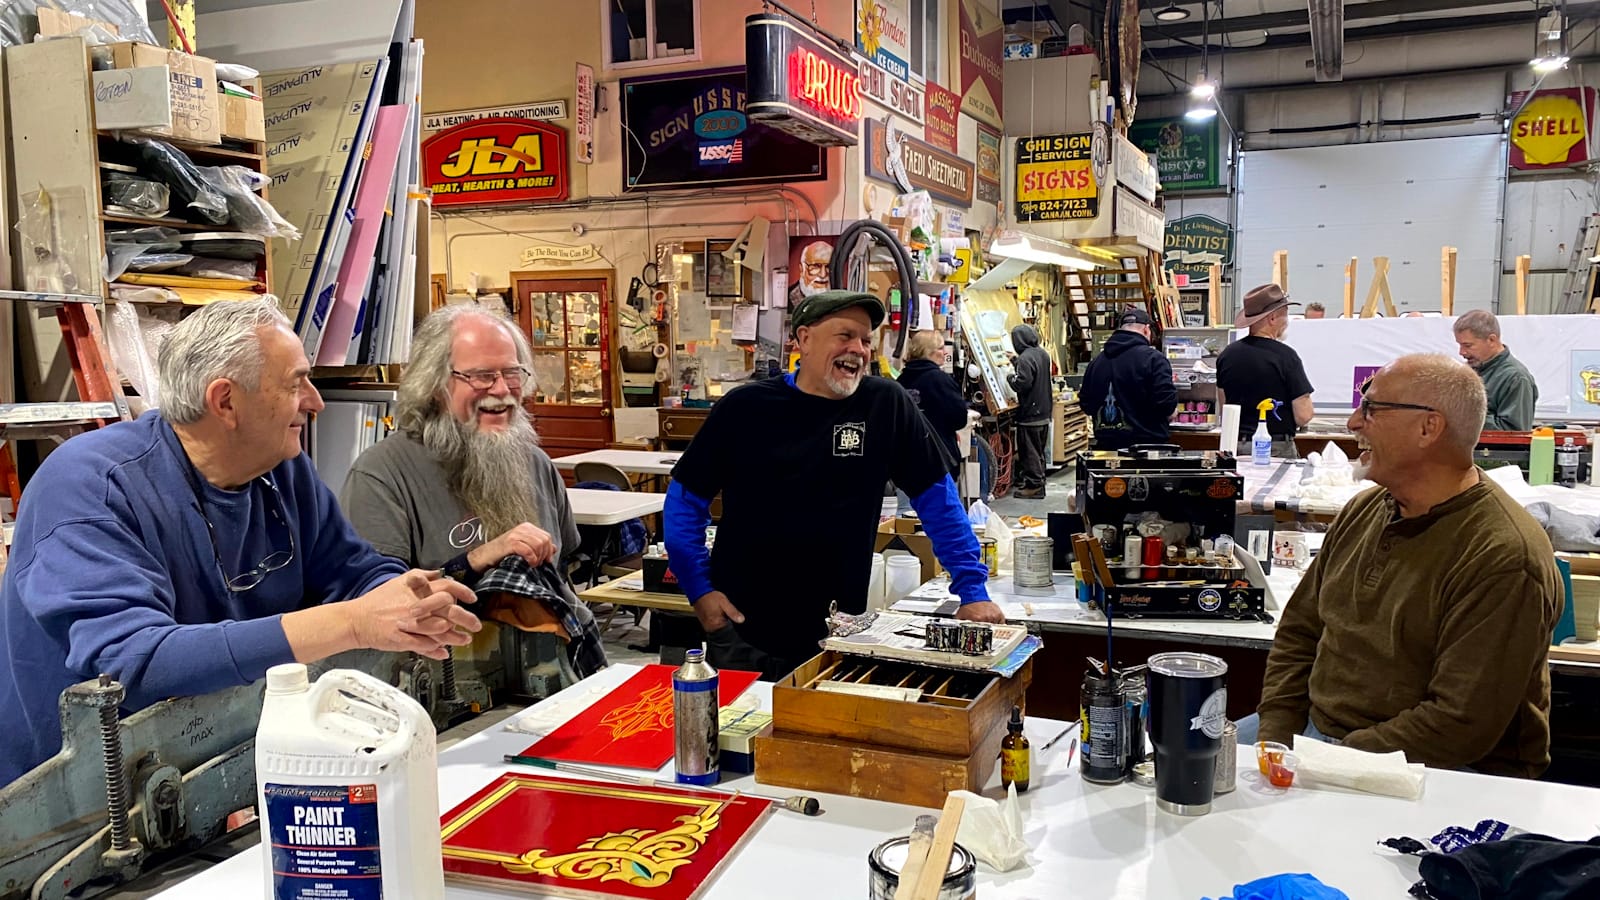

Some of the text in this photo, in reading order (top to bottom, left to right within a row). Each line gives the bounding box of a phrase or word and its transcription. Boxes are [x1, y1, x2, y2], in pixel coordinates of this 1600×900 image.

[877, 52, 906, 79] ICE CREAM
[171, 73, 198, 88] LINE
[266, 66, 323, 96] ALUPANEL
[802, 50, 863, 119] DRUGS
[859, 60, 921, 120] GHI SIGN
[427, 119, 441, 128] JLA
[443, 113, 475, 126] HEATING
[503, 105, 560, 118] CONDITIONING
[702, 116, 739, 132] 2000
[927, 113, 940, 132] AUTO
[650, 113, 689, 148] SIGN
[1517, 118, 1580, 137] SHELL
[699, 144, 733, 161] USSC
[1025, 135, 1091, 152] GHI SIGN
[441, 134, 543, 177] JLA
[904, 145, 926, 177] FAEDI
[1035, 150, 1080, 161] SERVICE
[432, 176, 554, 194] HEAT, HEARTH & MORE!
[1024, 167, 1090, 194] SIGNS
[1039, 199, 1088, 211] 824-7123
[1164, 234, 1230, 250] DENTIST
[535, 248, 546, 256] The
[558, 249, 568, 257] You
[582, 247, 590, 255] Be
[294, 806, 344, 826] PAINT
[285, 825, 356, 845] THINNER
